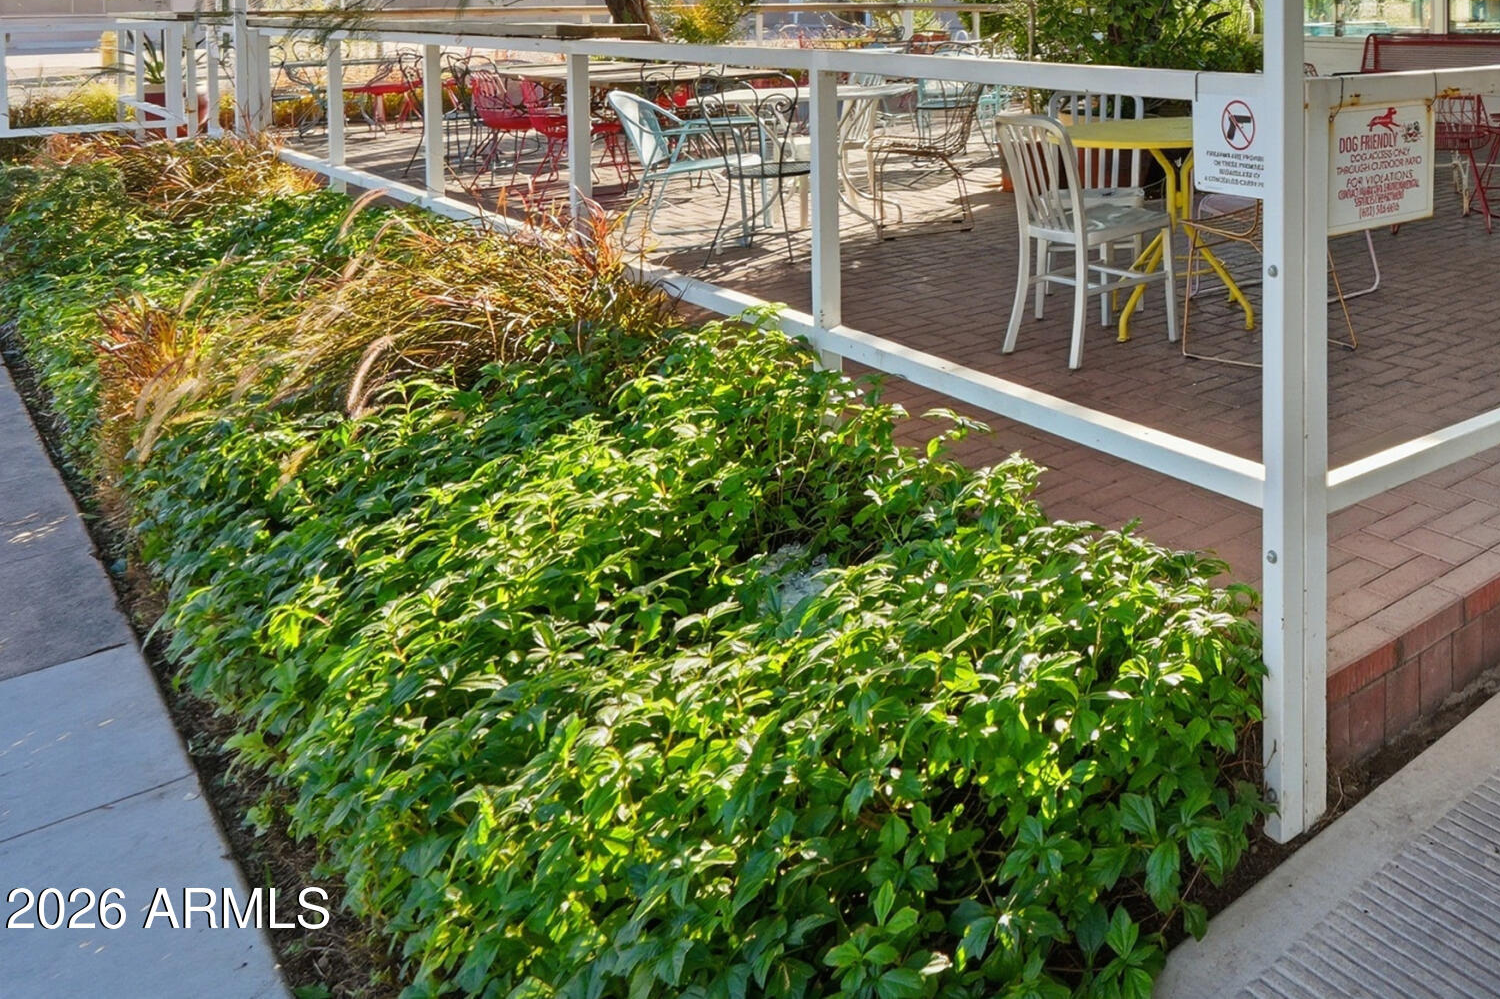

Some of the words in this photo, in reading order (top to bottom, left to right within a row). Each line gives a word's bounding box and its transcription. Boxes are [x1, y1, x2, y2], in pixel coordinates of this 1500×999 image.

[1338, 136, 1359, 154] DOG
[1360, 132, 1399, 151] FRIENDLY
[1350, 152, 1367, 163] DOG
[1368, 149, 1393, 161] ACCESS
[1336, 163, 1370, 176] THROUGH
[1370, 158, 1404, 171] OUTDOOR
[1346, 177, 1364, 188] FOR
[1365, 169, 1414, 185] VIOLATIONS
